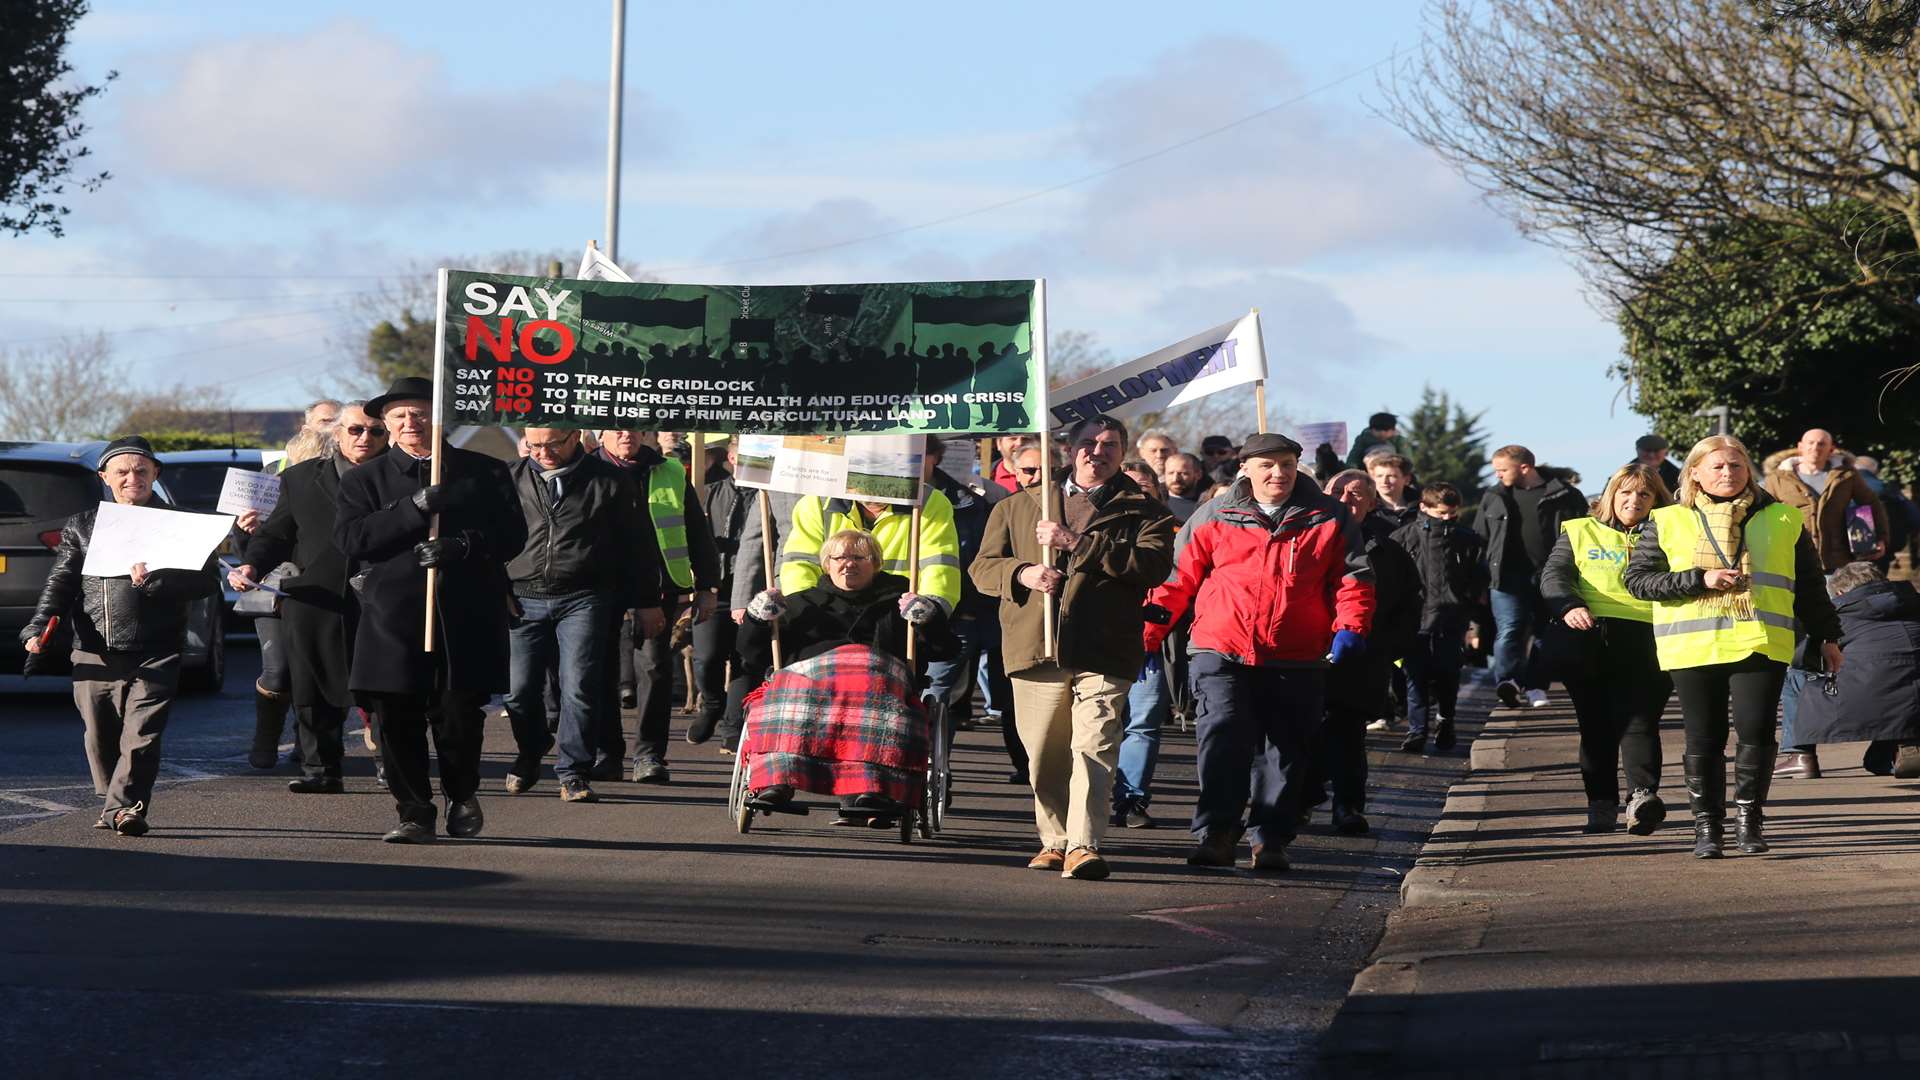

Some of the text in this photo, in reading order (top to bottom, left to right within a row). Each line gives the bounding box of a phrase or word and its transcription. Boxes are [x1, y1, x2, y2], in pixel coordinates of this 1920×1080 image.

[463, 282, 572, 320] SAY
[465, 316, 575, 364] NO
[456, 367, 755, 392] SAY NO TO TRAFFIC GRIDLOCK
[455, 382, 1025, 407] SAY NO TO THE INCREASED HEALTH AND EDUCATION CRISIS
[454, 398, 937, 421] SAY NO TO THE USE OF PRIME AGRCULTURAL LAND
